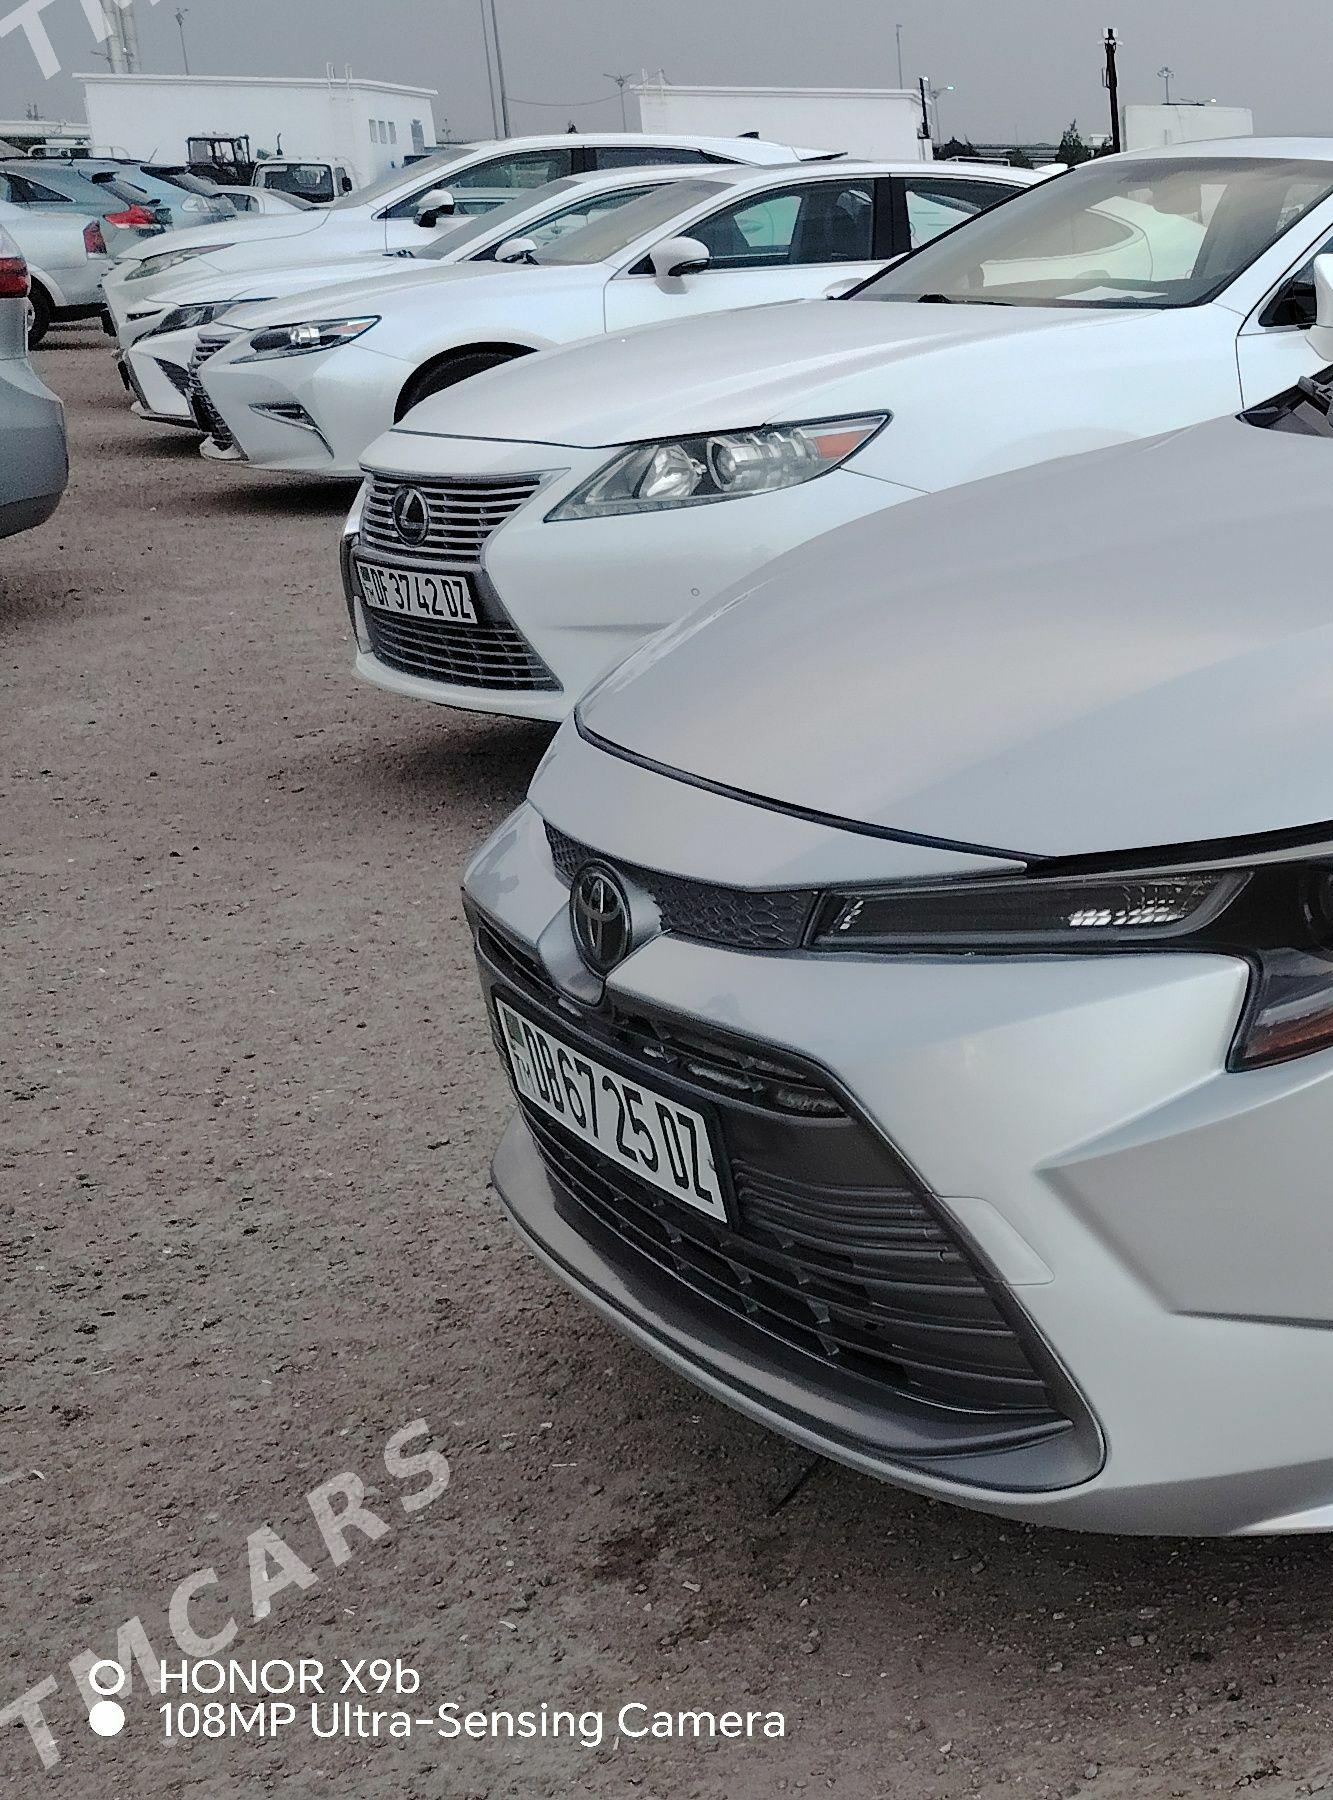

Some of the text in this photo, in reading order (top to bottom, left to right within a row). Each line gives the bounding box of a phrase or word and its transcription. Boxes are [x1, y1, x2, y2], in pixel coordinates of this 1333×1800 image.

[369, 567, 390, 607] DF
[388, 572, 411, 611] 37
[414, 576, 445, 616] 42
[440, 578, 472, 619] DZ
[522, 1022, 566, 1114] DB
[557, 1047, 600, 1140] 67
[601, 1074, 659, 1173] 25
[655, 1100, 715, 1205] DZ
